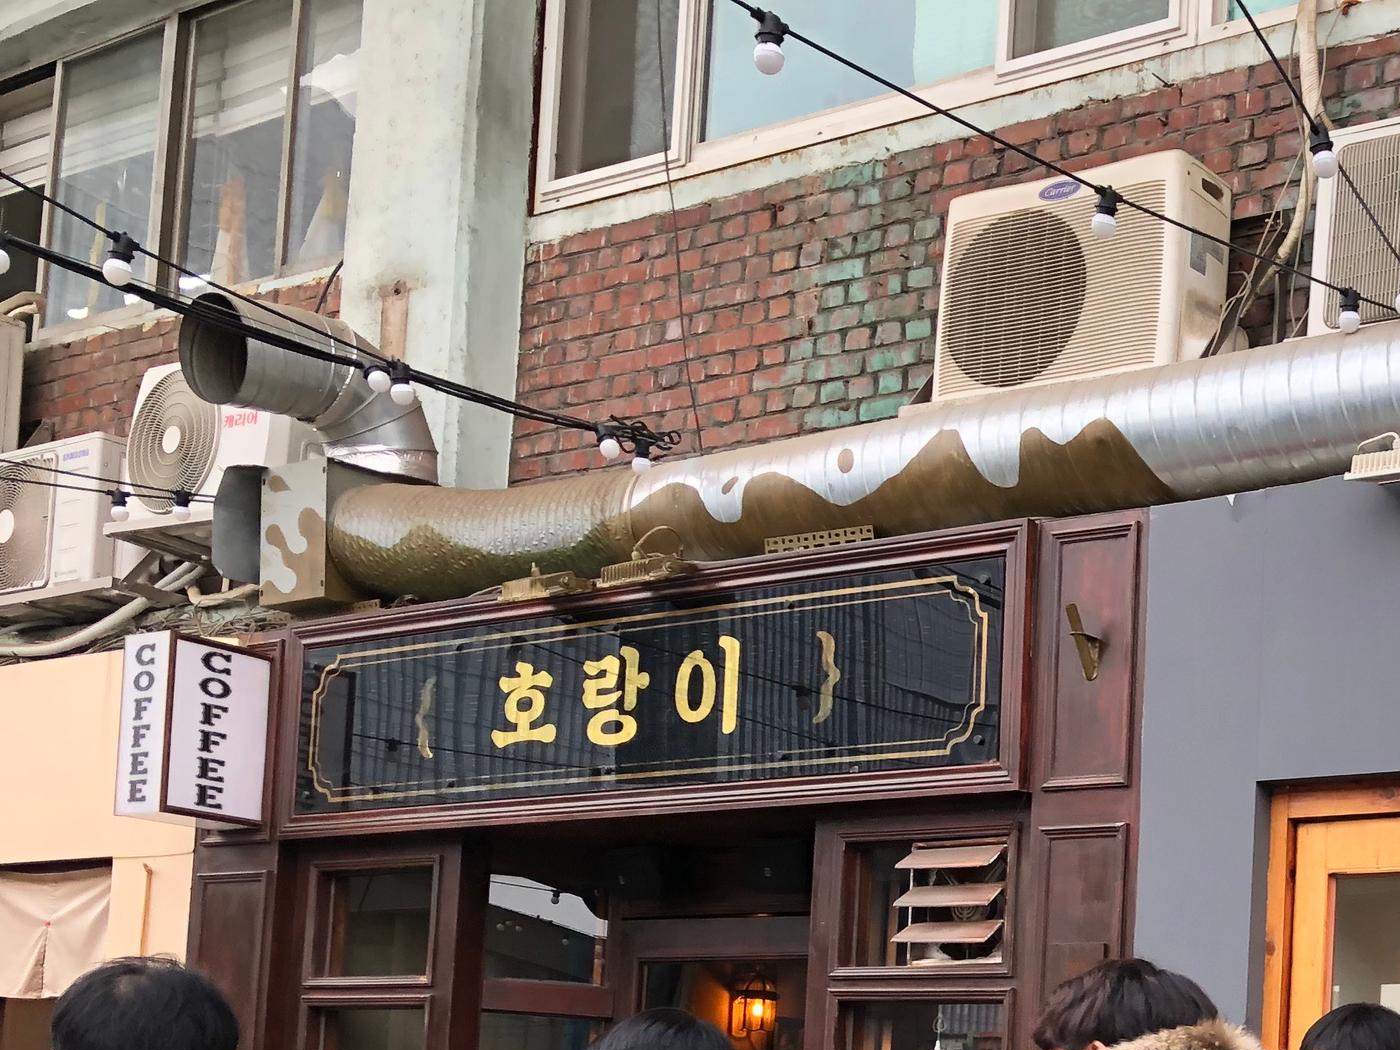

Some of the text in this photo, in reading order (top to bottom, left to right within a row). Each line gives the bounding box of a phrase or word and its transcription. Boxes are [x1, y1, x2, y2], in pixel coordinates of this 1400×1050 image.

[1043, 183, 1078, 198] Carrier
[127, 642, 157, 803] COFFEE
[193, 650, 233, 810] COFFEE
[490, 634, 741, 748] 호랑이
